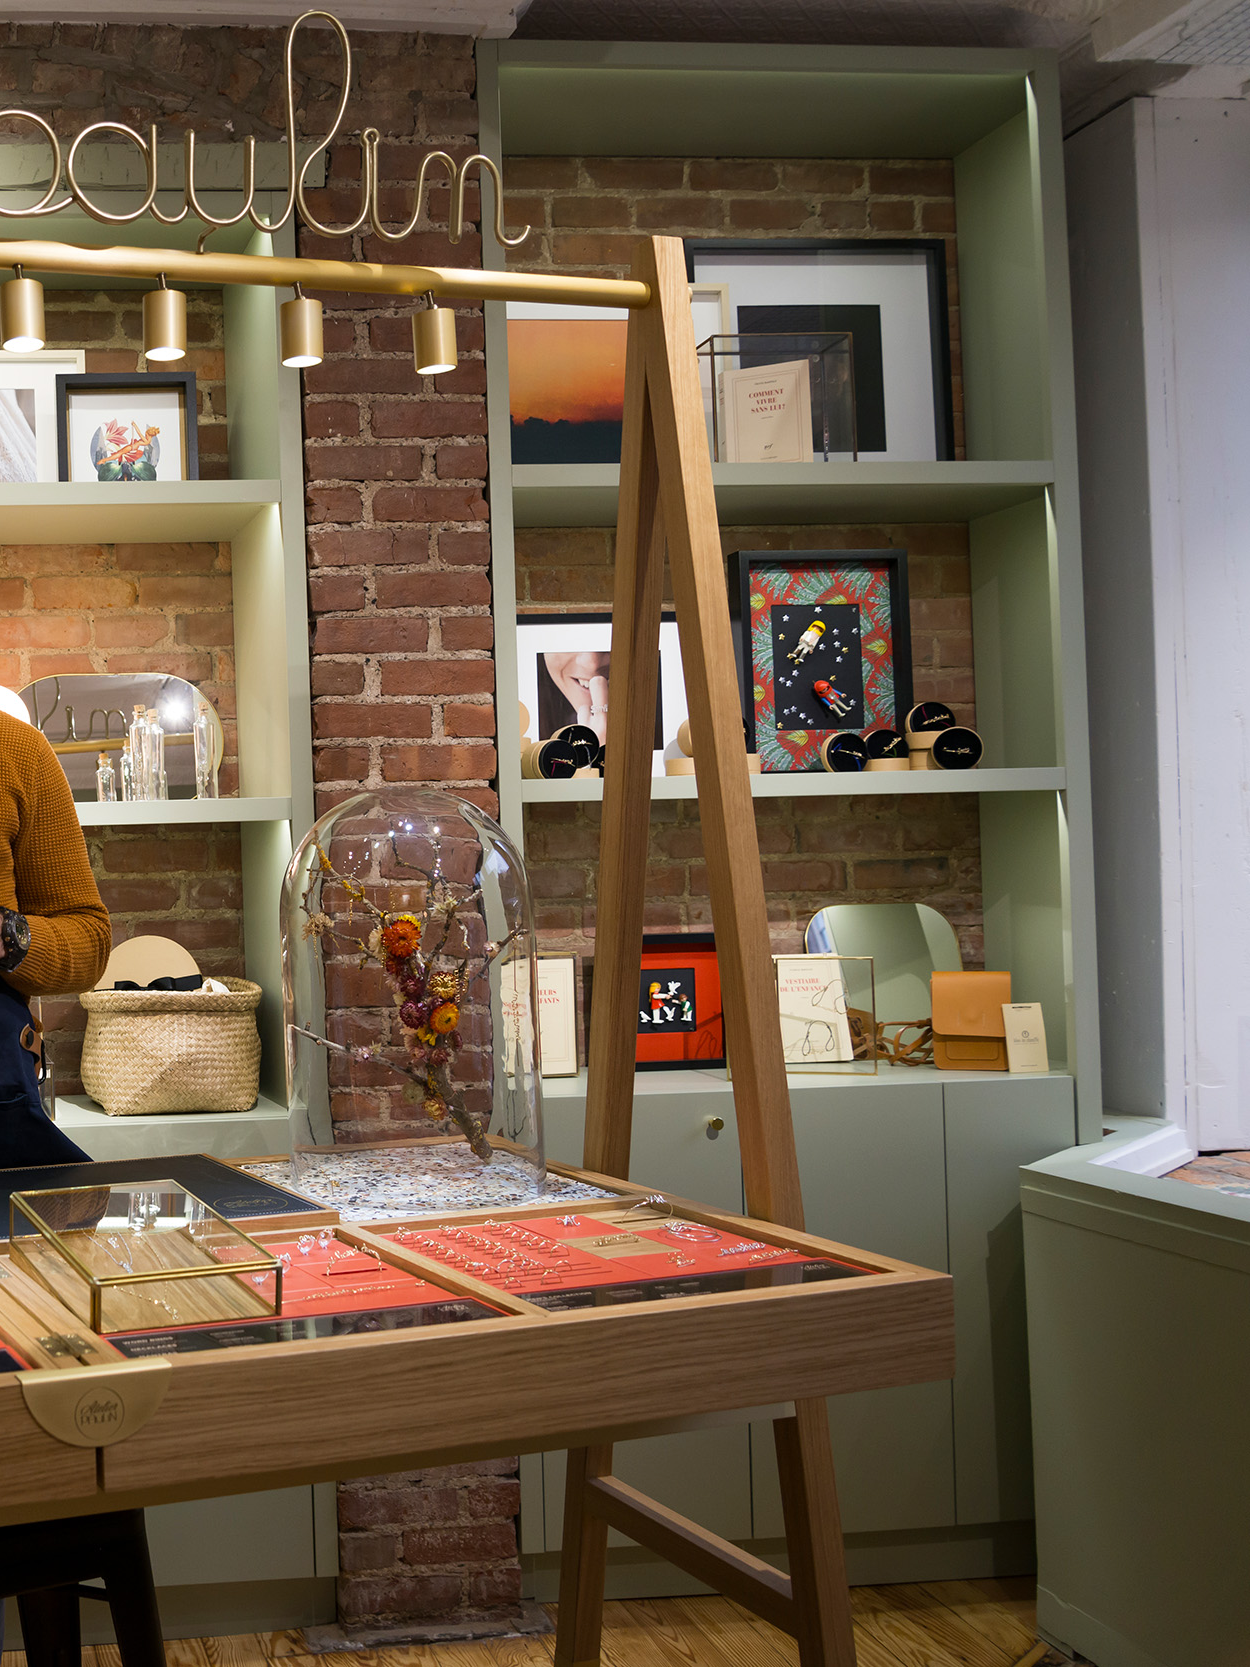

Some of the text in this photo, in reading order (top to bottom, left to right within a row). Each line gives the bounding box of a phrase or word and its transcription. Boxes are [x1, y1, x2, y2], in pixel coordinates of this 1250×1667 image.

[748, 388, 784, 399] COMMENT
[756, 397, 776, 405] VIVRE
[751, 406, 768, 414] SANS
[780, 985, 789, 993] DE
